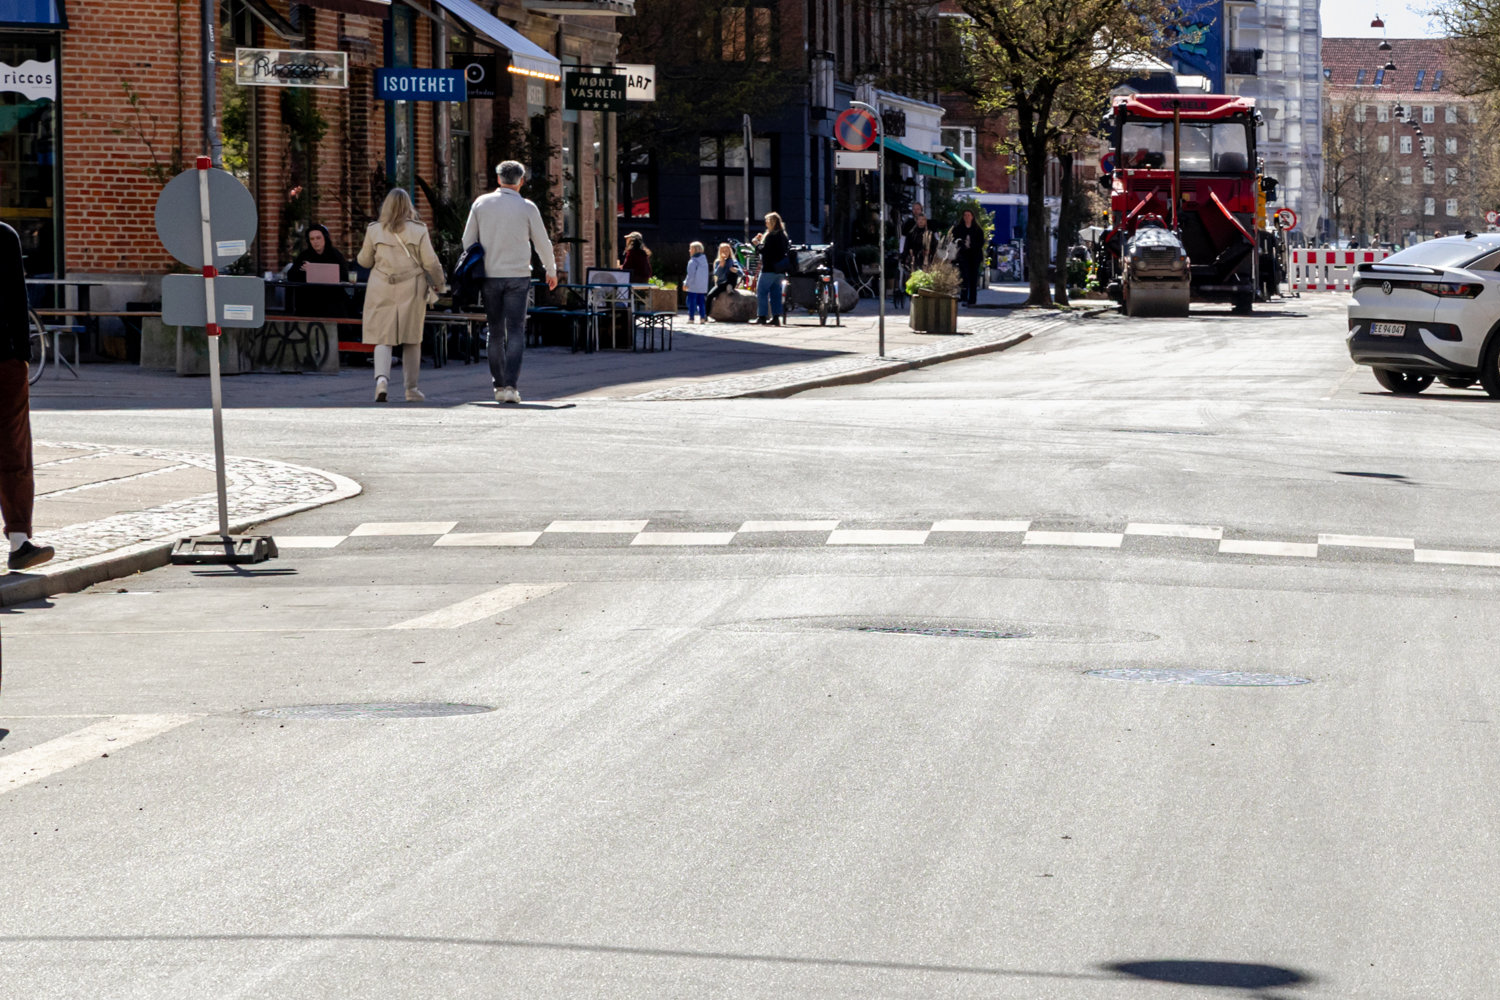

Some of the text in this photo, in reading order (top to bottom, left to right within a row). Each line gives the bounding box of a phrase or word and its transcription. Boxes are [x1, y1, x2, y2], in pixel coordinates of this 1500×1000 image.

[4, 71, 52, 84] riccos
[579, 77, 613, 87] MØNT
[571, 88, 622, 99] VASKERI
[1383, 324, 1391, 333] 94
[1391, 324, 1404, 334] 047
